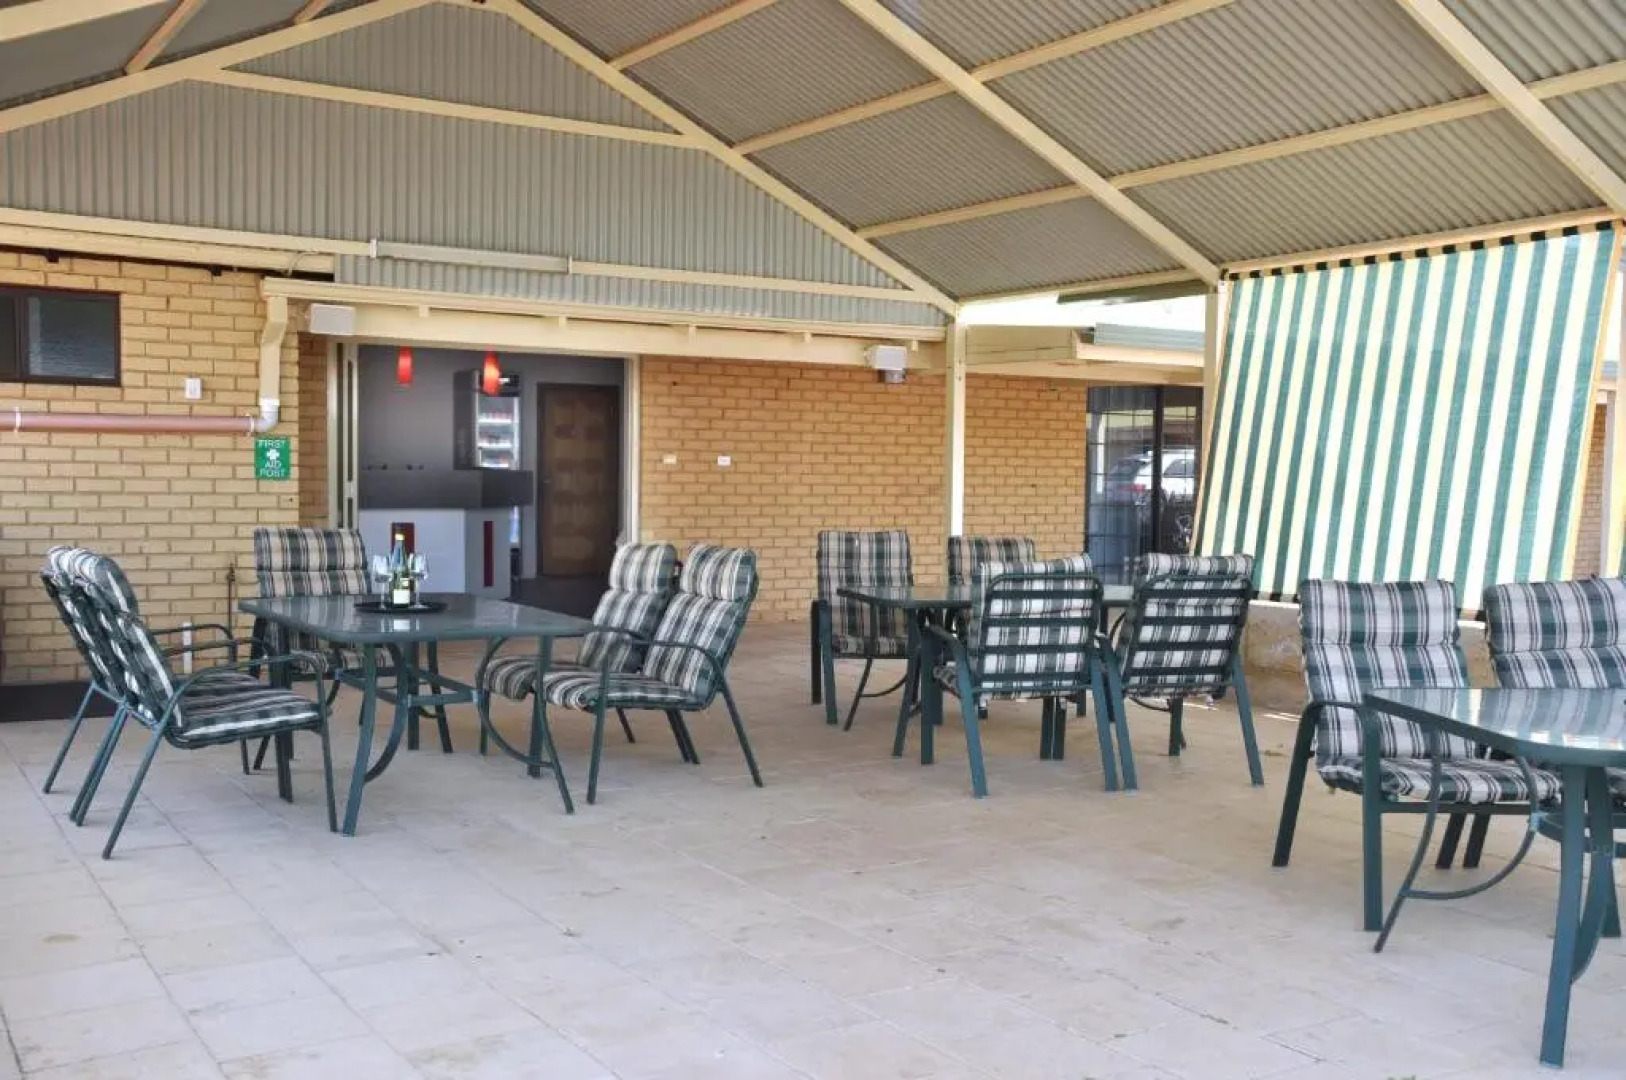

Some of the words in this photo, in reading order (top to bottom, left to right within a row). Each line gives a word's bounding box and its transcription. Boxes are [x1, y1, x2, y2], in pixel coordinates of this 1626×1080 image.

[258, 439, 285, 448] FIRST
[265, 460, 282, 468] AID
[260, 469, 285, 477] POST
